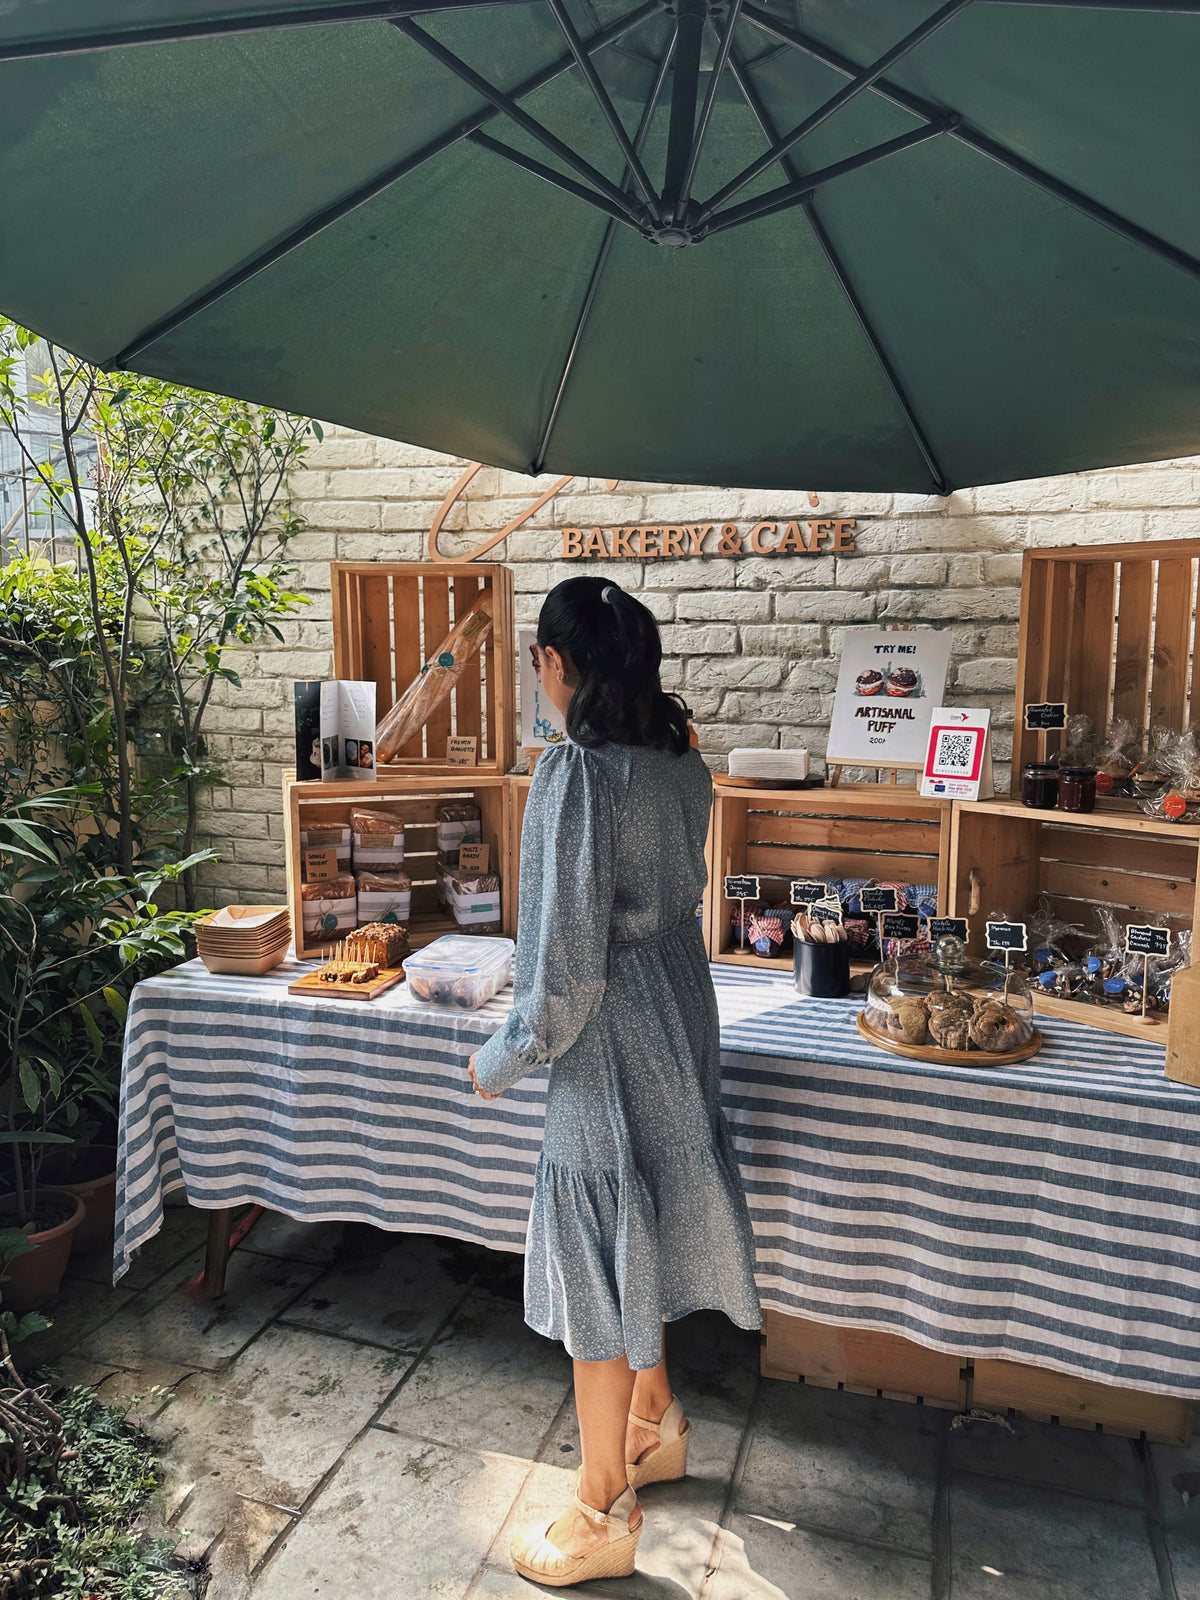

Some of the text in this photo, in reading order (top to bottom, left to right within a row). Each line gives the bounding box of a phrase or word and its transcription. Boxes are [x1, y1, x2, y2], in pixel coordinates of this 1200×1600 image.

[560, 519, 856, 558] BAKERY & CAFE
[874, 645, 917, 654] TRY ME!
[854, 706, 916, 720] ARTISANAL
[867, 720, 897, 734] PUFF
